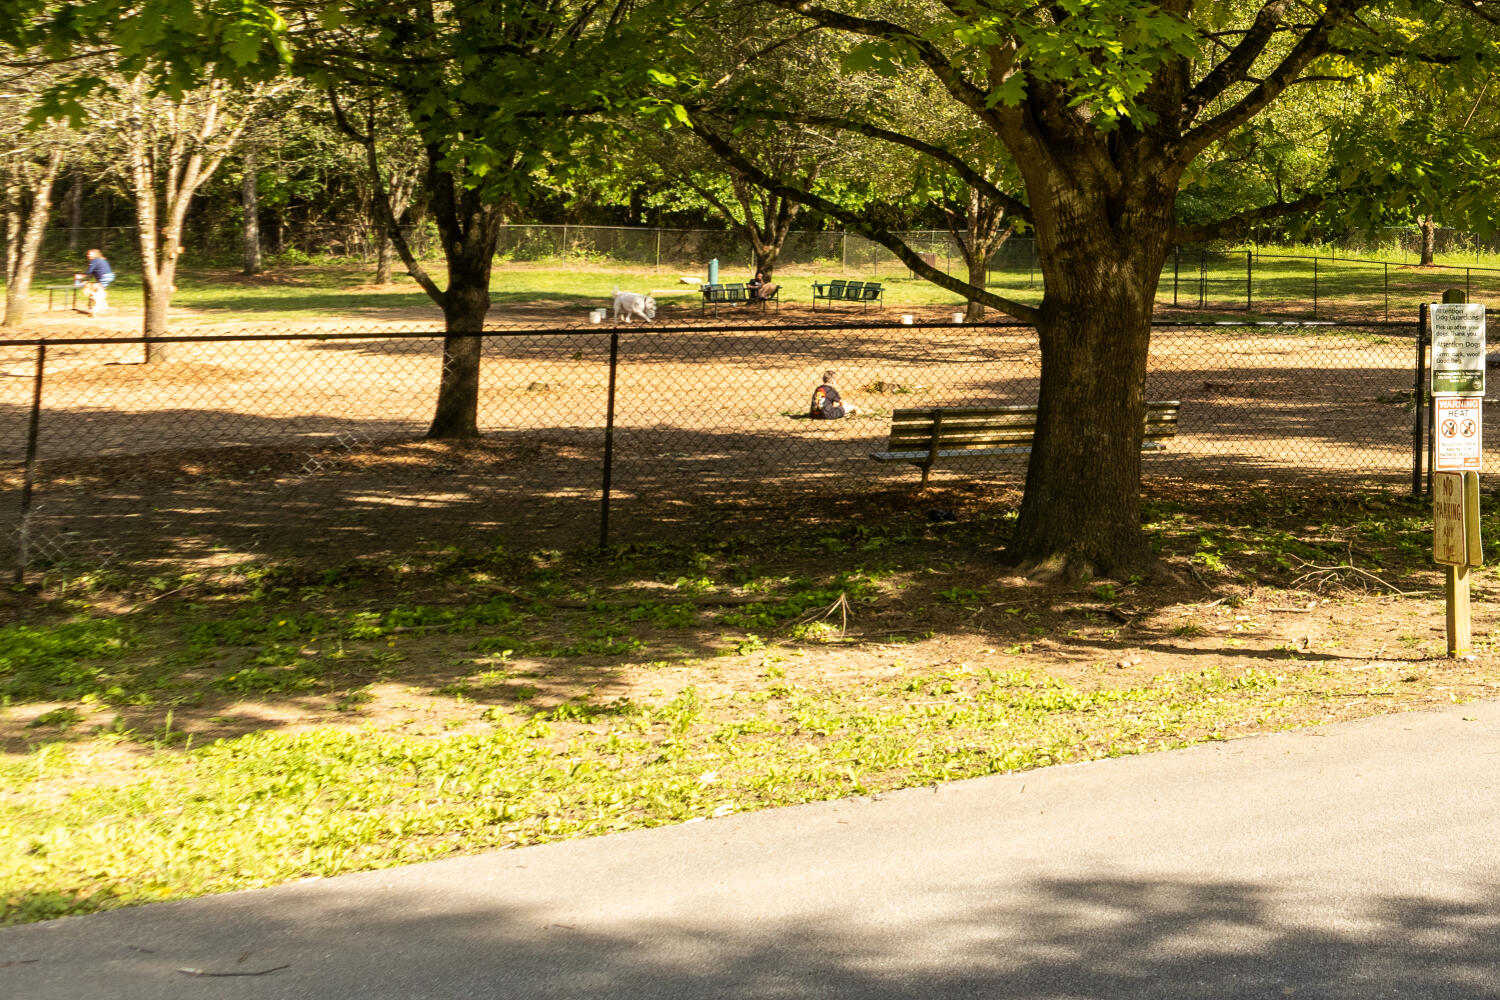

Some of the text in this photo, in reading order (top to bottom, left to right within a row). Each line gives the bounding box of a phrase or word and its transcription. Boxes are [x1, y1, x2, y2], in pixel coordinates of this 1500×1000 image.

[1443, 478, 1453, 496] NO
[1437, 502, 1460, 520] PARKING
[1444, 527, 1454, 537] ANY
[1443, 544, 1454, 556] TIME
